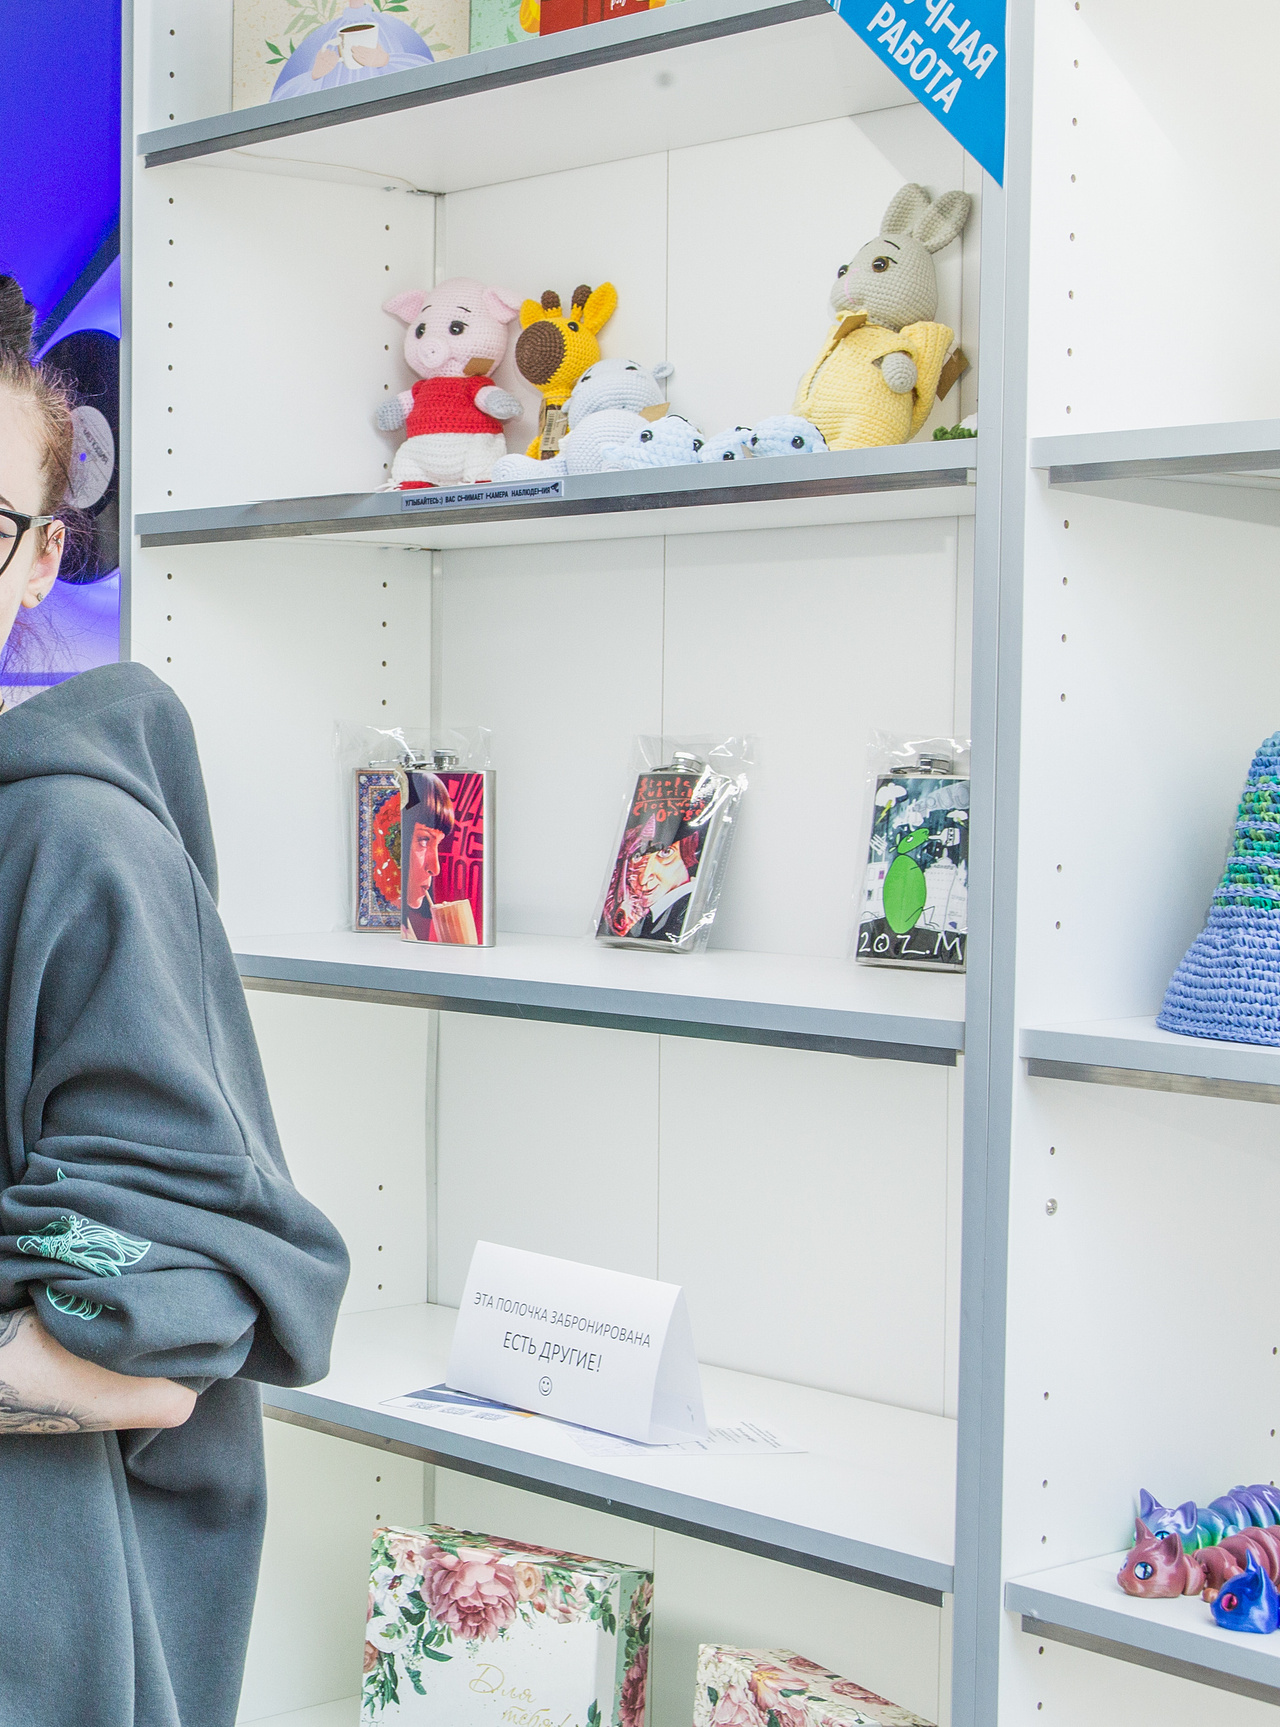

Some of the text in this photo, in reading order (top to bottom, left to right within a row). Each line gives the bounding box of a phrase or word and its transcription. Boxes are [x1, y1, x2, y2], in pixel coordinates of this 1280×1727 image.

[866, 1, 963, 114] РАБОТА
[903, 0, 999, 80] ЧНАЯ
[457, 493, 484, 502] СНИМАЕТ
[485, 491, 509, 499] КАМЕРА
[511, 487, 551, 497] НАБЛЮДЕНИЯ
[473, 1291, 651, 1348] ЭТА ПОЛОЧКА ЗАБРОНИРОВАНА
[503, 1331, 603, 1373] ЕСТЬ ДРУГИЕ!
[469, 1663, 537, 1703] Для
